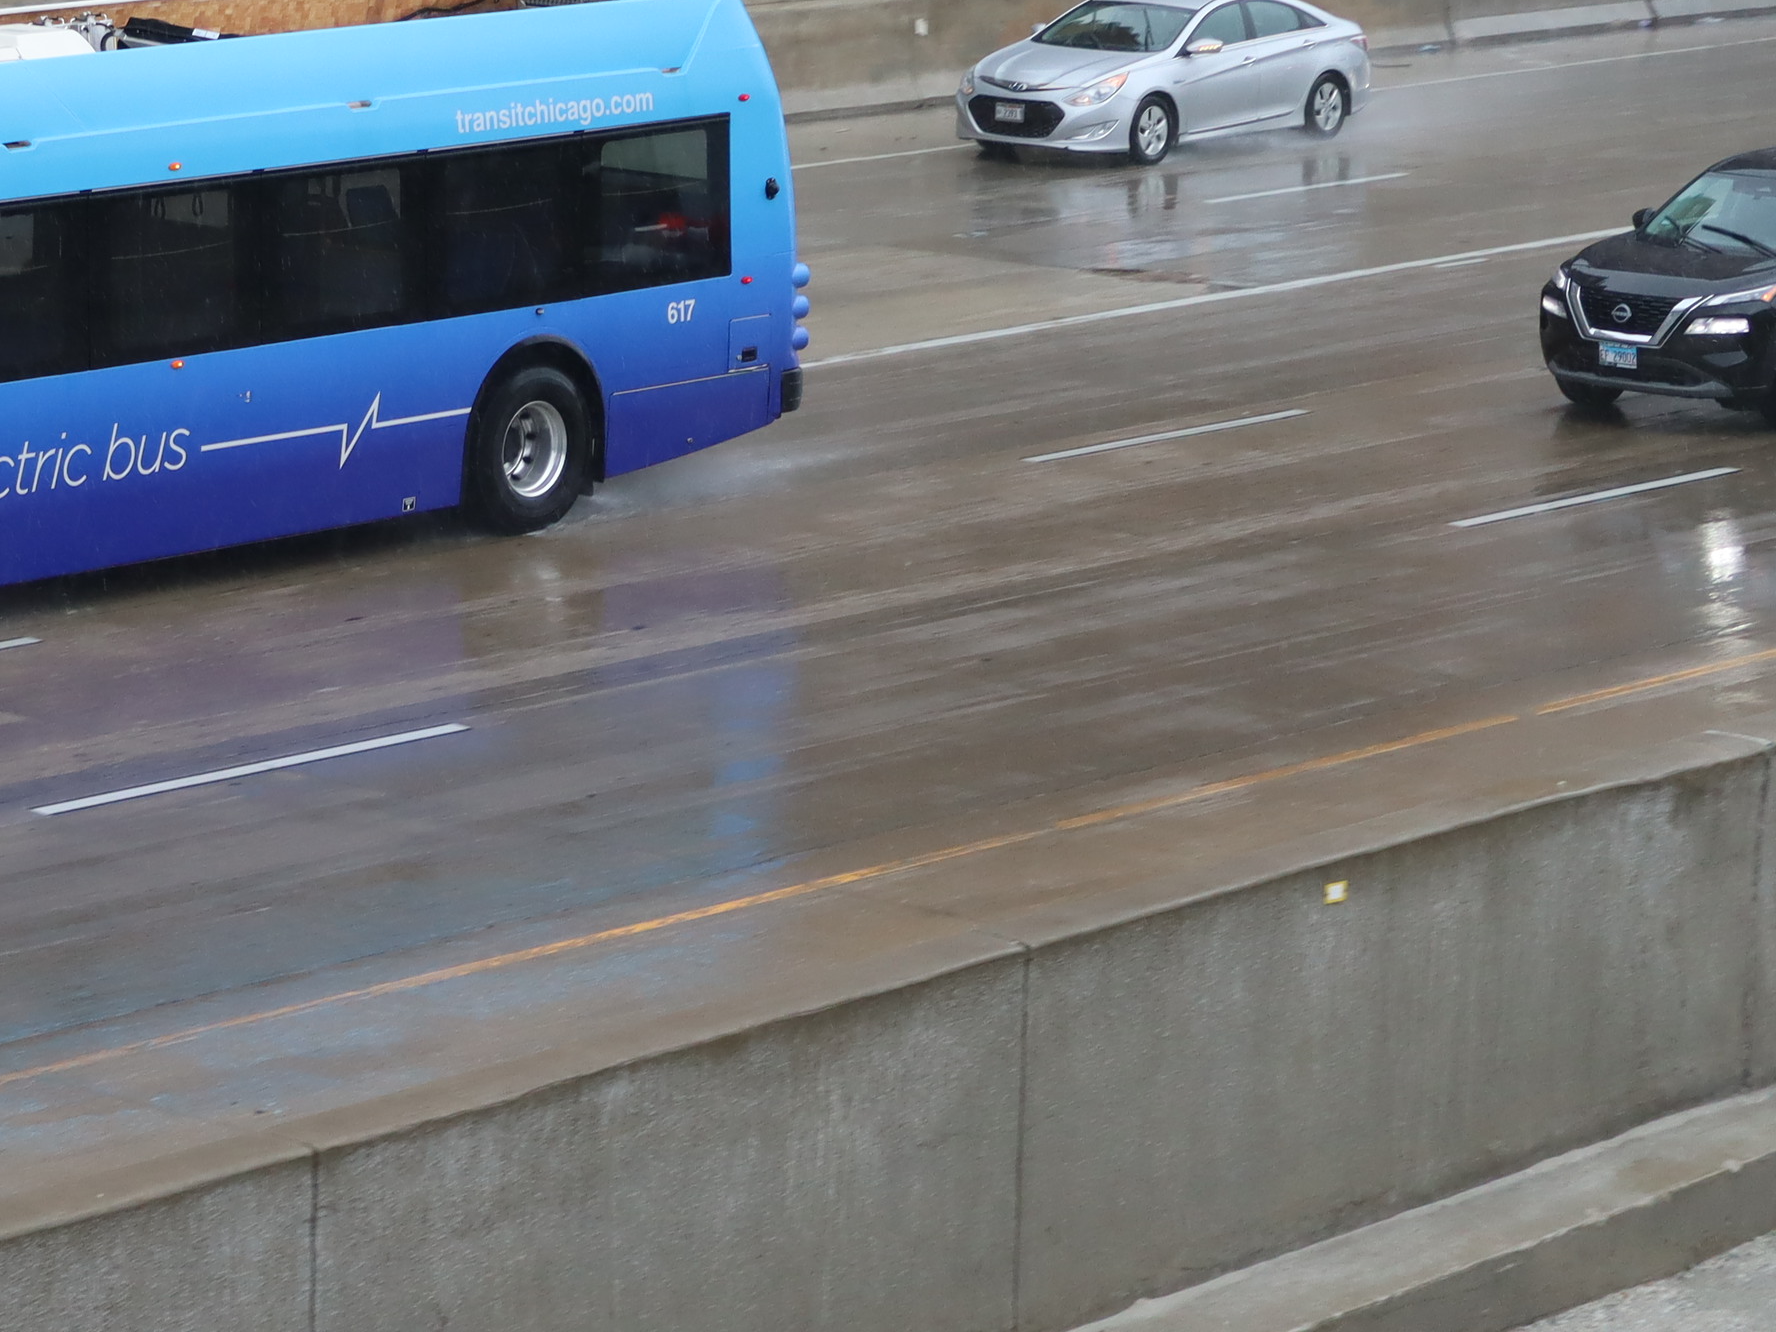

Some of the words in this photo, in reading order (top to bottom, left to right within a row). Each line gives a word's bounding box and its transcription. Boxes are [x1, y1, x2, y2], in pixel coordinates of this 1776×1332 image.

[455, 92, 654, 134] transitchicago.com
[667, 298, 696, 325] 617
[102, 422, 191, 482] bus
